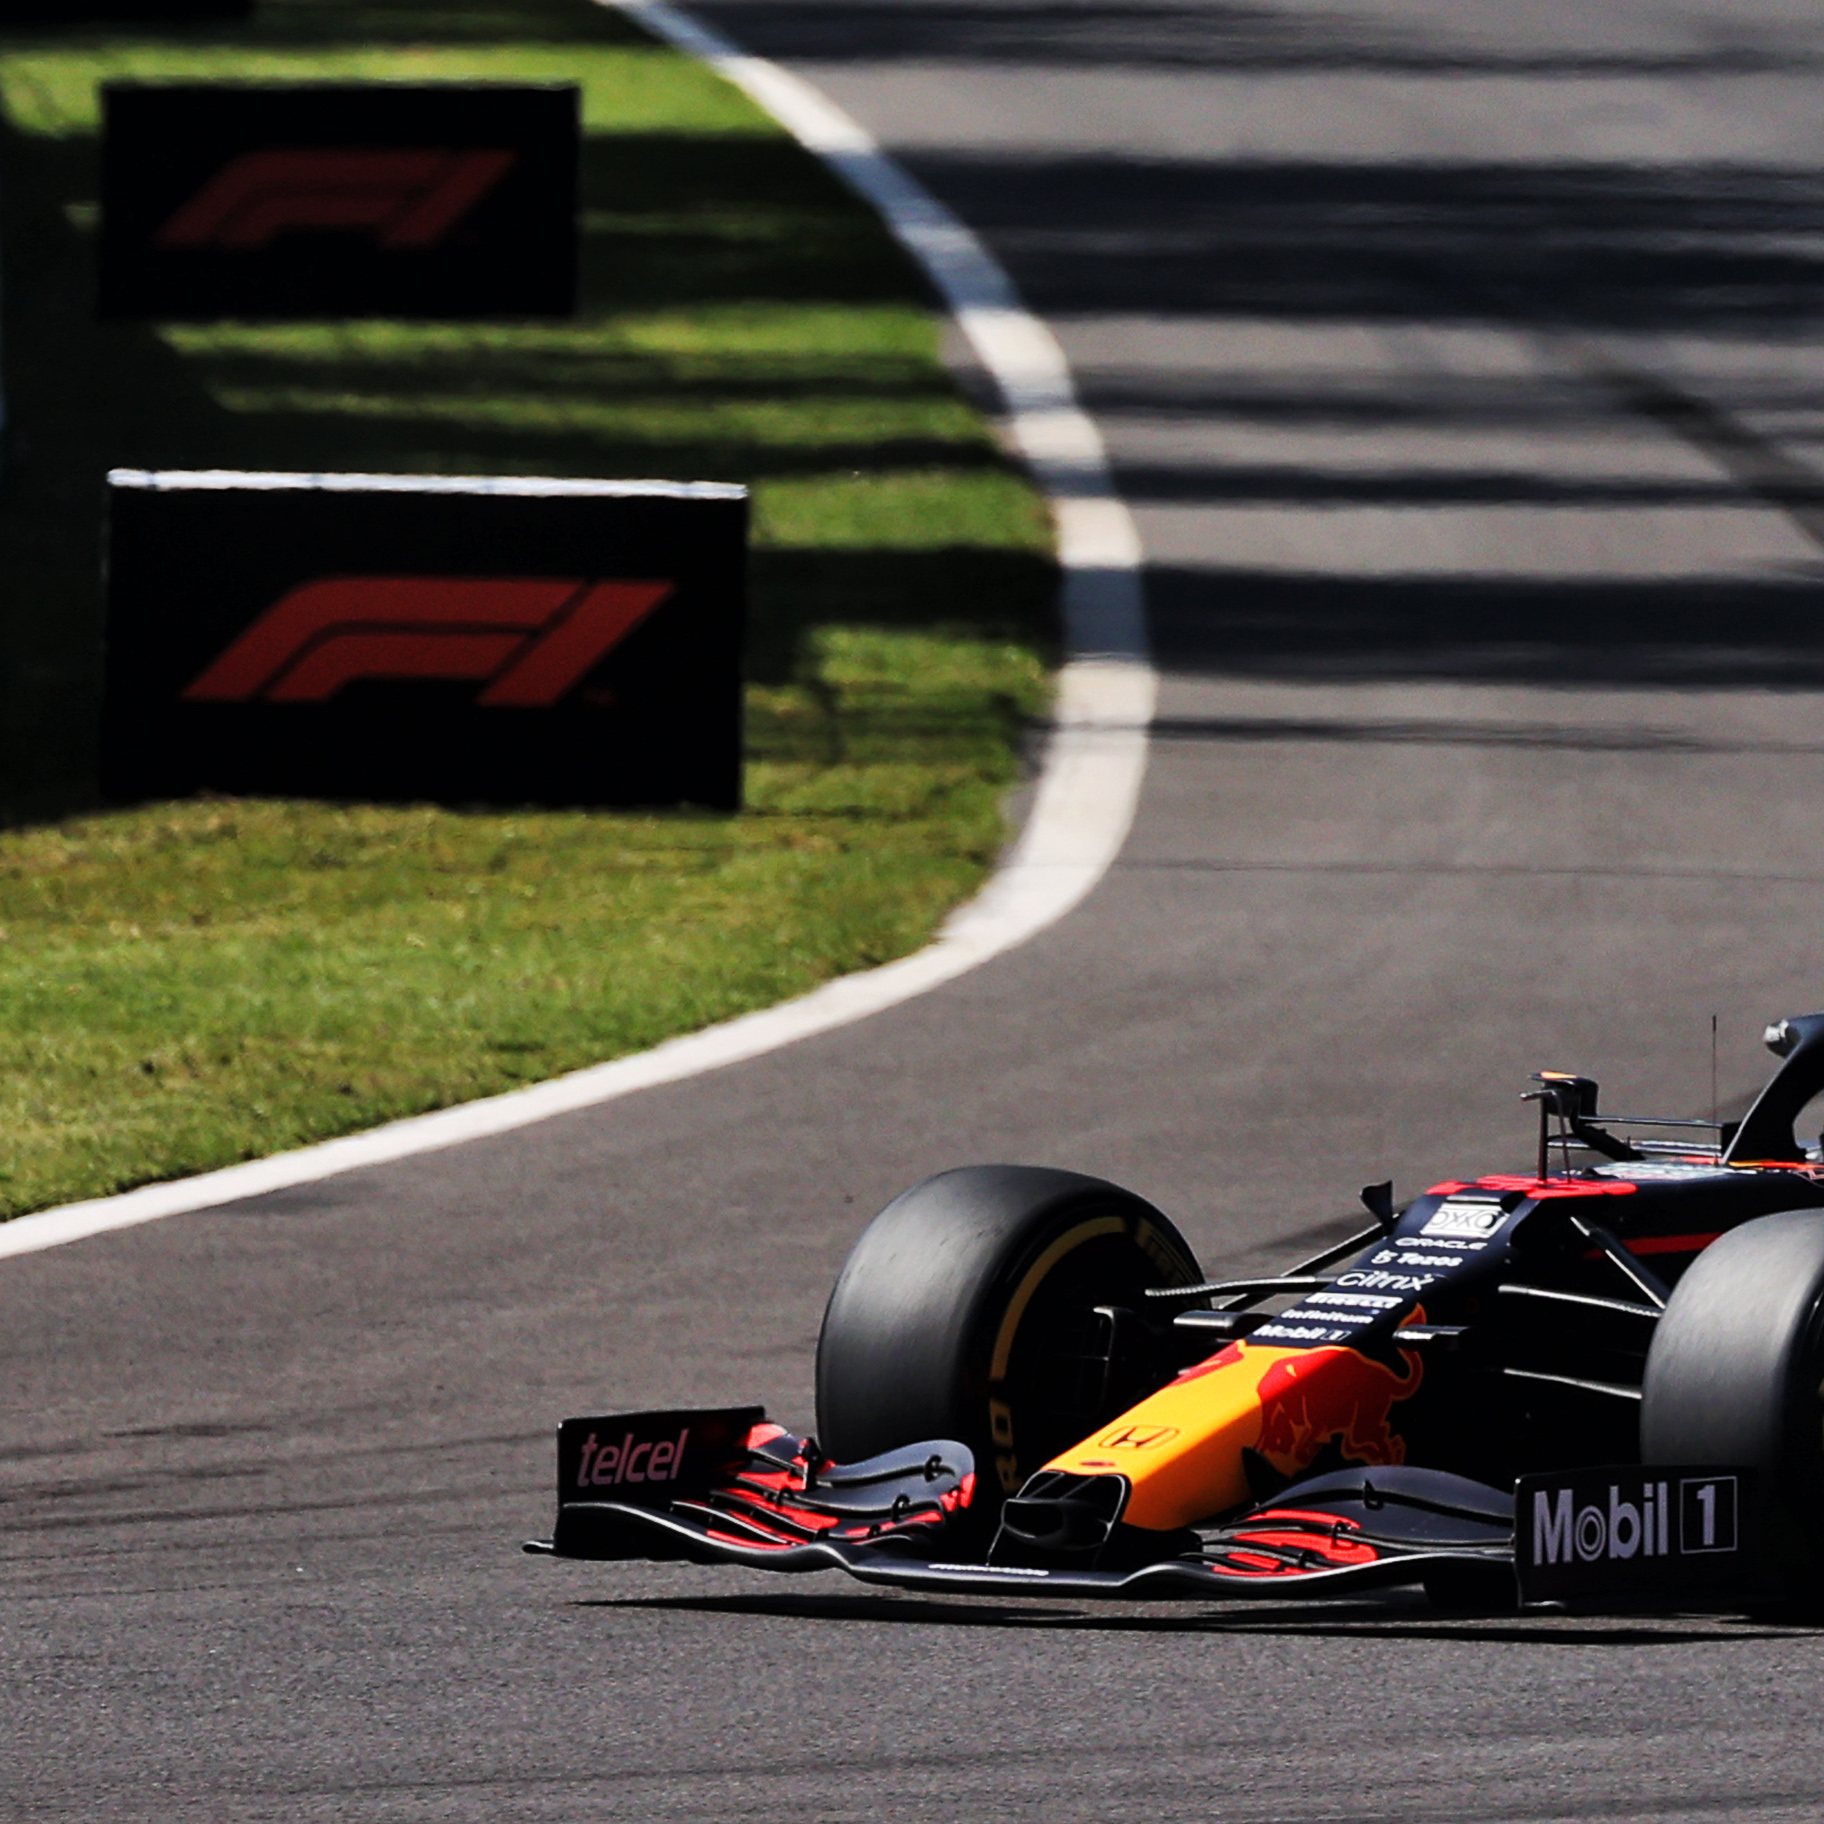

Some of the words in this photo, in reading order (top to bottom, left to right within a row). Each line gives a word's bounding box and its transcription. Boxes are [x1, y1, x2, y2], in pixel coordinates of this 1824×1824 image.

[1395, 1237, 1488, 1250] ORACLE
[1397, 1252, 1464, 1267] Tezos
[1336, 1270, 1435, 1292] citrix
[1280, 1309, 1374, 1324] infinitum
[1253, 1324, 1327, 1340] Mobil
[576, 1428, 690, 1487] telcel
[1532, 1480, 1669, 1567] Mobil
